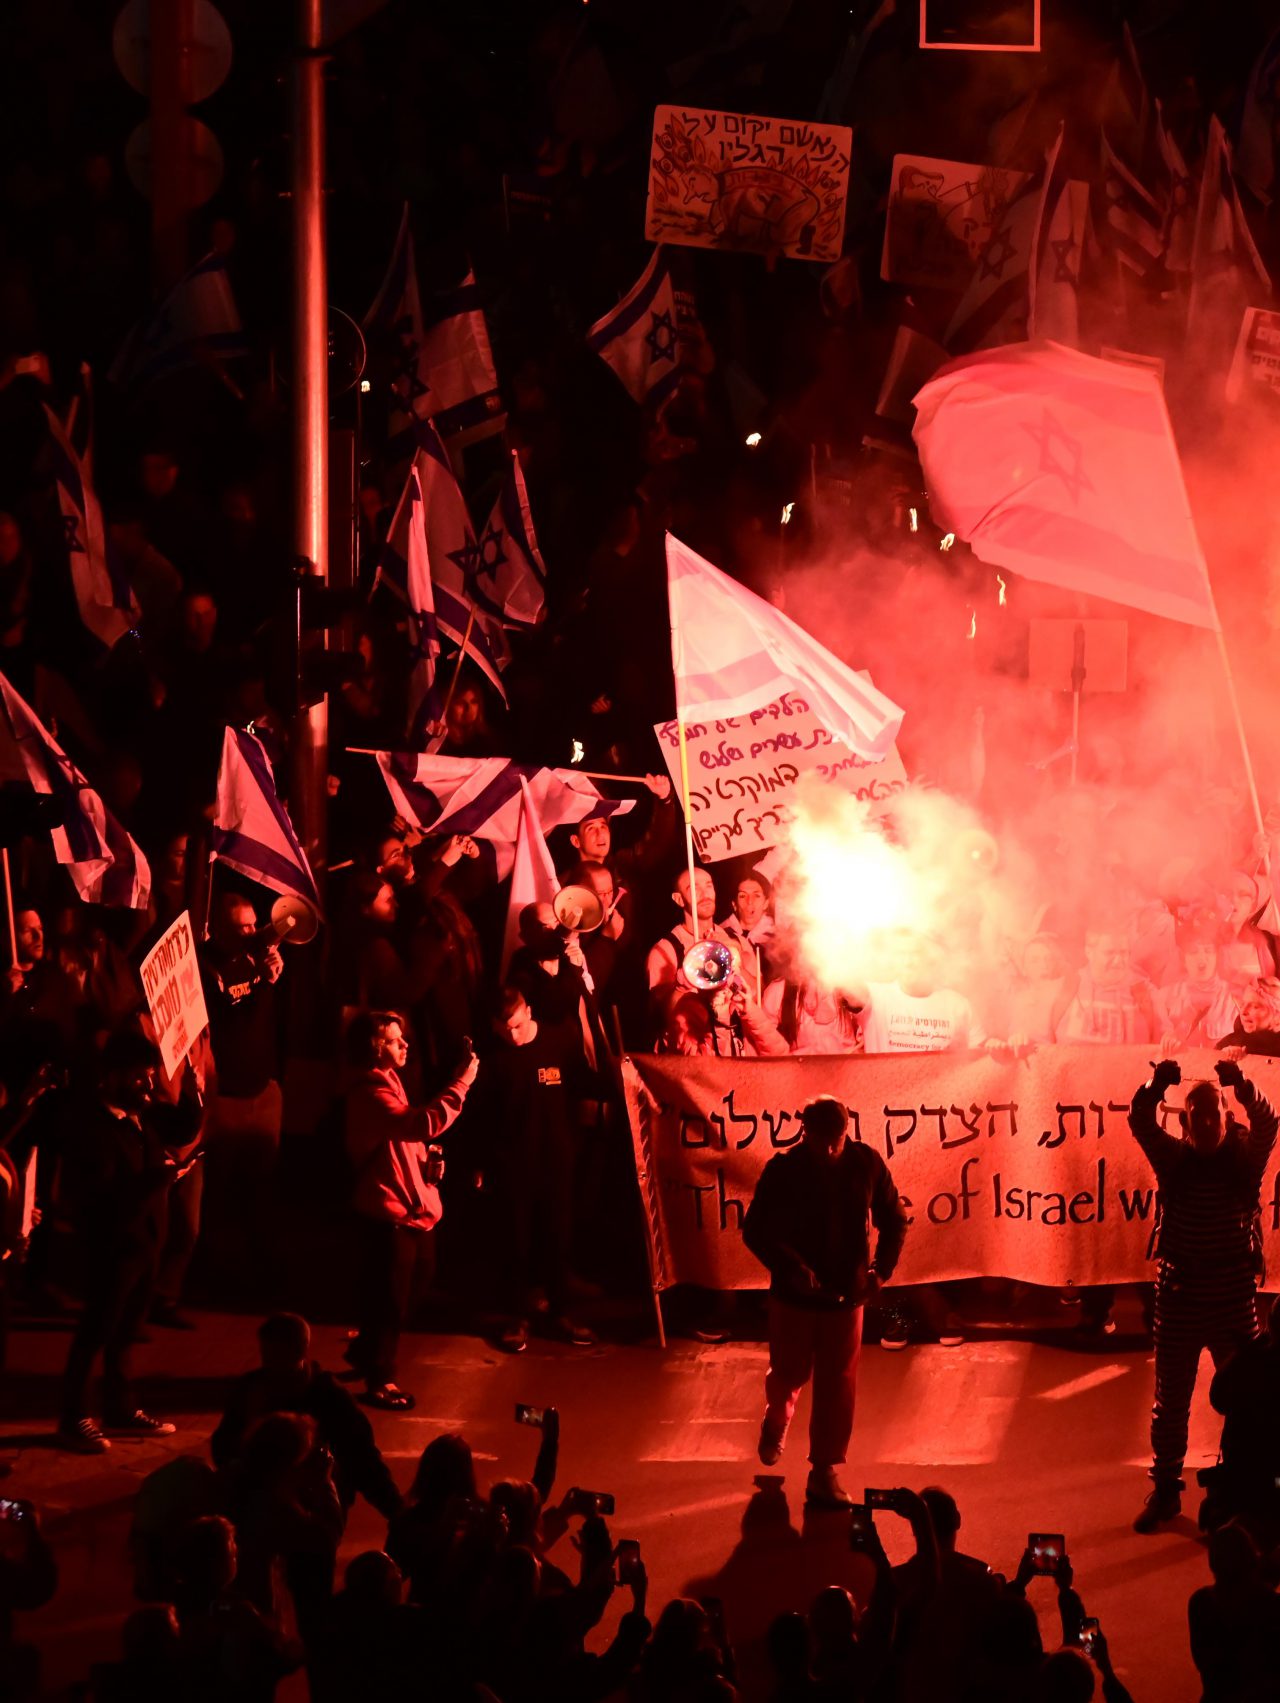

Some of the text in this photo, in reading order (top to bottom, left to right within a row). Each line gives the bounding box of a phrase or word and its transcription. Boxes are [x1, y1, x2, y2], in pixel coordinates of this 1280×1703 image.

[682, 112, 849, 173] הנאשם יקום על
[720, 136, 785, 164] רגליו
[680, 1089, 862, 1150] ושלום
[883, 1100, 1019, 1159] הצדק
[683, 1167, 744, 1230] Th
[926, 1157, 980, 1225] of
[992, 1157, 1106, 1226] Israel
